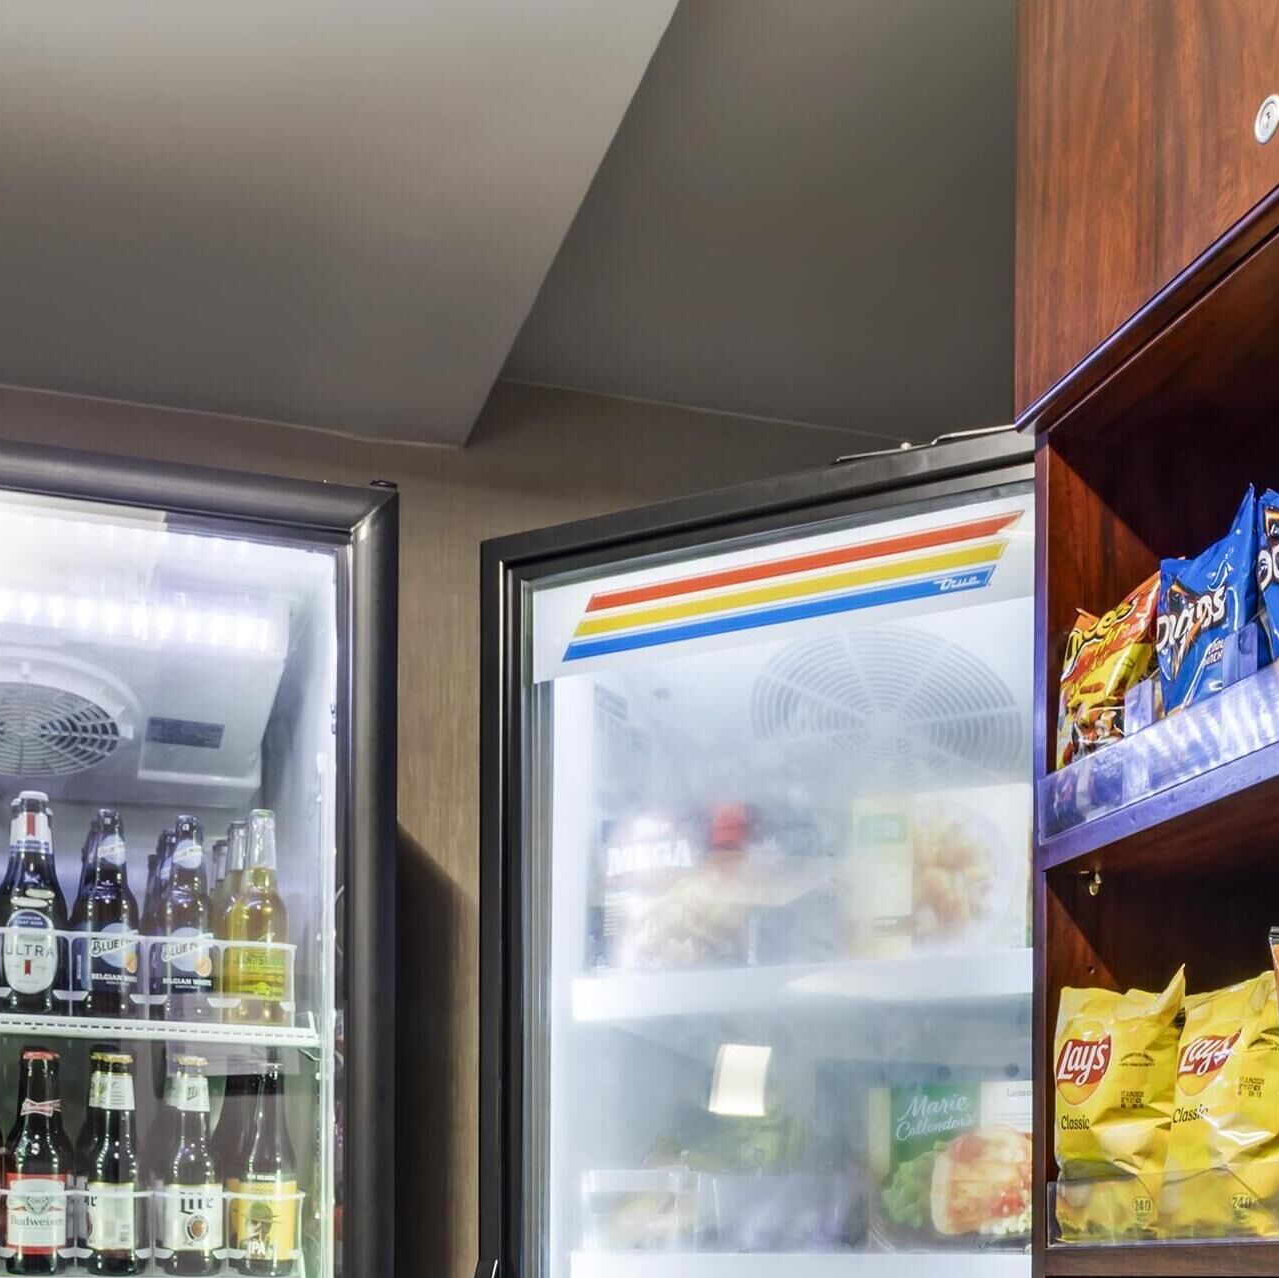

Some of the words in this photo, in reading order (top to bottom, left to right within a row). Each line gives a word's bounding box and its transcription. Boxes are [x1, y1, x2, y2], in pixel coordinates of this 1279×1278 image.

[1056, 1037, 1109, 1086] Lay's
[907, 1094, 970, 1118] Marie
[1060, 1115, 1090, 1132] Classic
[248, 1241, 267, 1257] IPA
